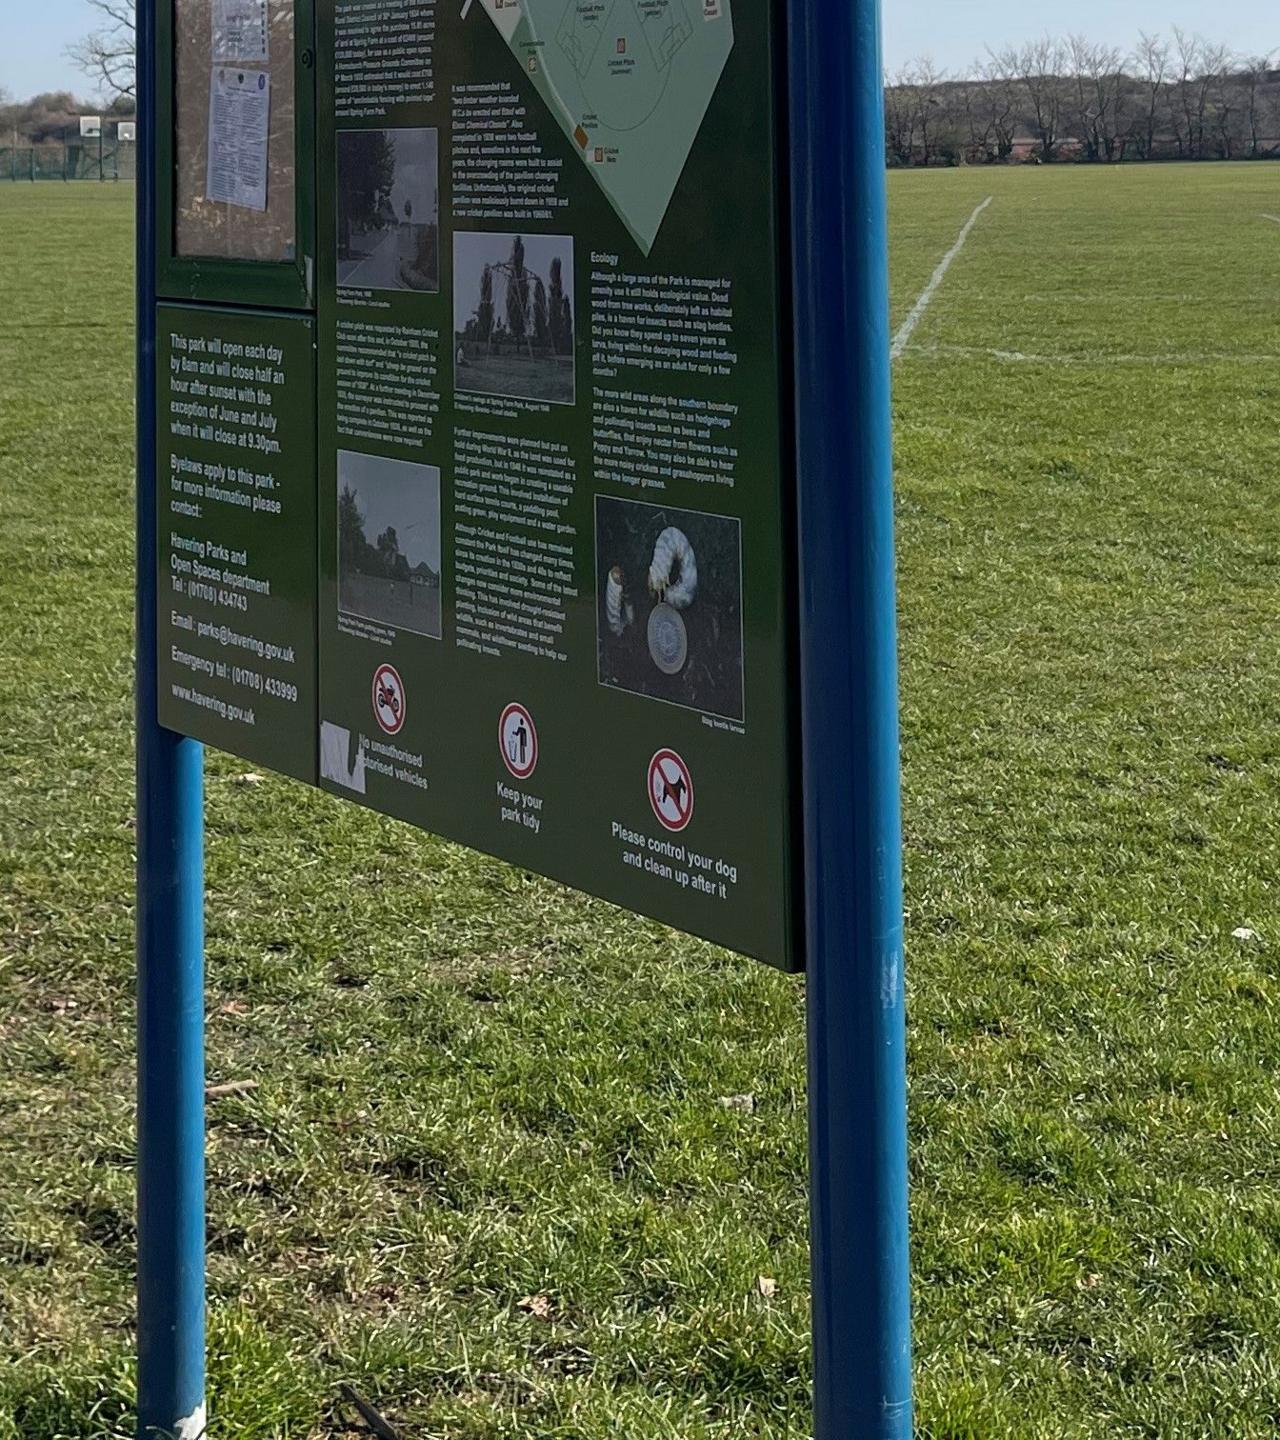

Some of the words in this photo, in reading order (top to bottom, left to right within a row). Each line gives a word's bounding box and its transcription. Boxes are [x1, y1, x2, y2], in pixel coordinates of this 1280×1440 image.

[590, 251, 618, 266] Ecology
[669, 276, 683, 285] Park
[170, 332, 186, 348] This
[188, 336, 205, 353] park
[207, 338, 221, 353] will
[223, 342, 242, 358] open
[245, 343, 265, 358] each
[266, 344, 282, 365] day
[170, 354, 180, 373] by
[200, 359, 214, 374] and
[216, 361, 230, 376] will
[232, 363, 253, 380] close
[255, 365, 271, 382] half
[273, 372, 284, 384] an
[170, 375, 188, 392] hour
[190, 379, 207, 395] after
[209, 385, 236, 400] sunset
[238, 386, 255, 403] with
[257, 388, 271, 405] the
[170, 400, 207, 418] exception
[209, 404, 218, 419] of
[219, 405, 238, 422] June
[241, 410, 256, 425] and
[259, 411, 276, 433] July
[170, 419, 190, 436] when
[192, 422, 197, 437] it
[199, 425, 213, 440] will
[215, 427, 236, 444] close
[238, 431, 246, 446] at
[248, 432, 281, 454] 9.30pm.
[170, 453, 201, 473] Byelaws
[203, 462, 225, 483] apply
[227, 464, 236, 480] to
[237, 466, 253, 484] this
[255, 472, 274, 490] park
[170, 474, 182, 491] for
[183, 481, 203, 496] more
[205, 482, 250, 506] information
[253, 493, 281, 513] please
[170, 531, 204, 558] Havering
[206, 540, 228, 560] Parks
[230, 549, 246, 565] and
[170, 553, 191, 574] Open
[192, 559, 220, 581] Spaces
[222, 567, 269, 594] department
[218, 588, 247, 611] 434743
[197, 621, 294, 663] parks@havering.gov.uk
[171, 645, 214, 677] Emergency
[232, 665, 263, 694] (01708)
[265, 676, 297, 702] 433999
[172, 683, 254, 725] www.havering.gov.uk
[371, 741, 422, 768] unauthorised
[394, 768, 428, 790] vehicles
[496, 780, 519, 806] Keep
[522, 793, 542, 810] your
[501, 807, 520, 823] park
[522, 811, 539, 834] tidy
[611, 820, 644, 847] Please
[647, 837, 684, 861] control
[687, 851, 712, 871] your
[715, 857, 736, 883] dog
[623, 850, 641, 868] and
[644, 856, 671, 879] clean
[674, 869, 688, 888] up
[691, 874, 715, 895] after
[718, 881, 726, 899] it
